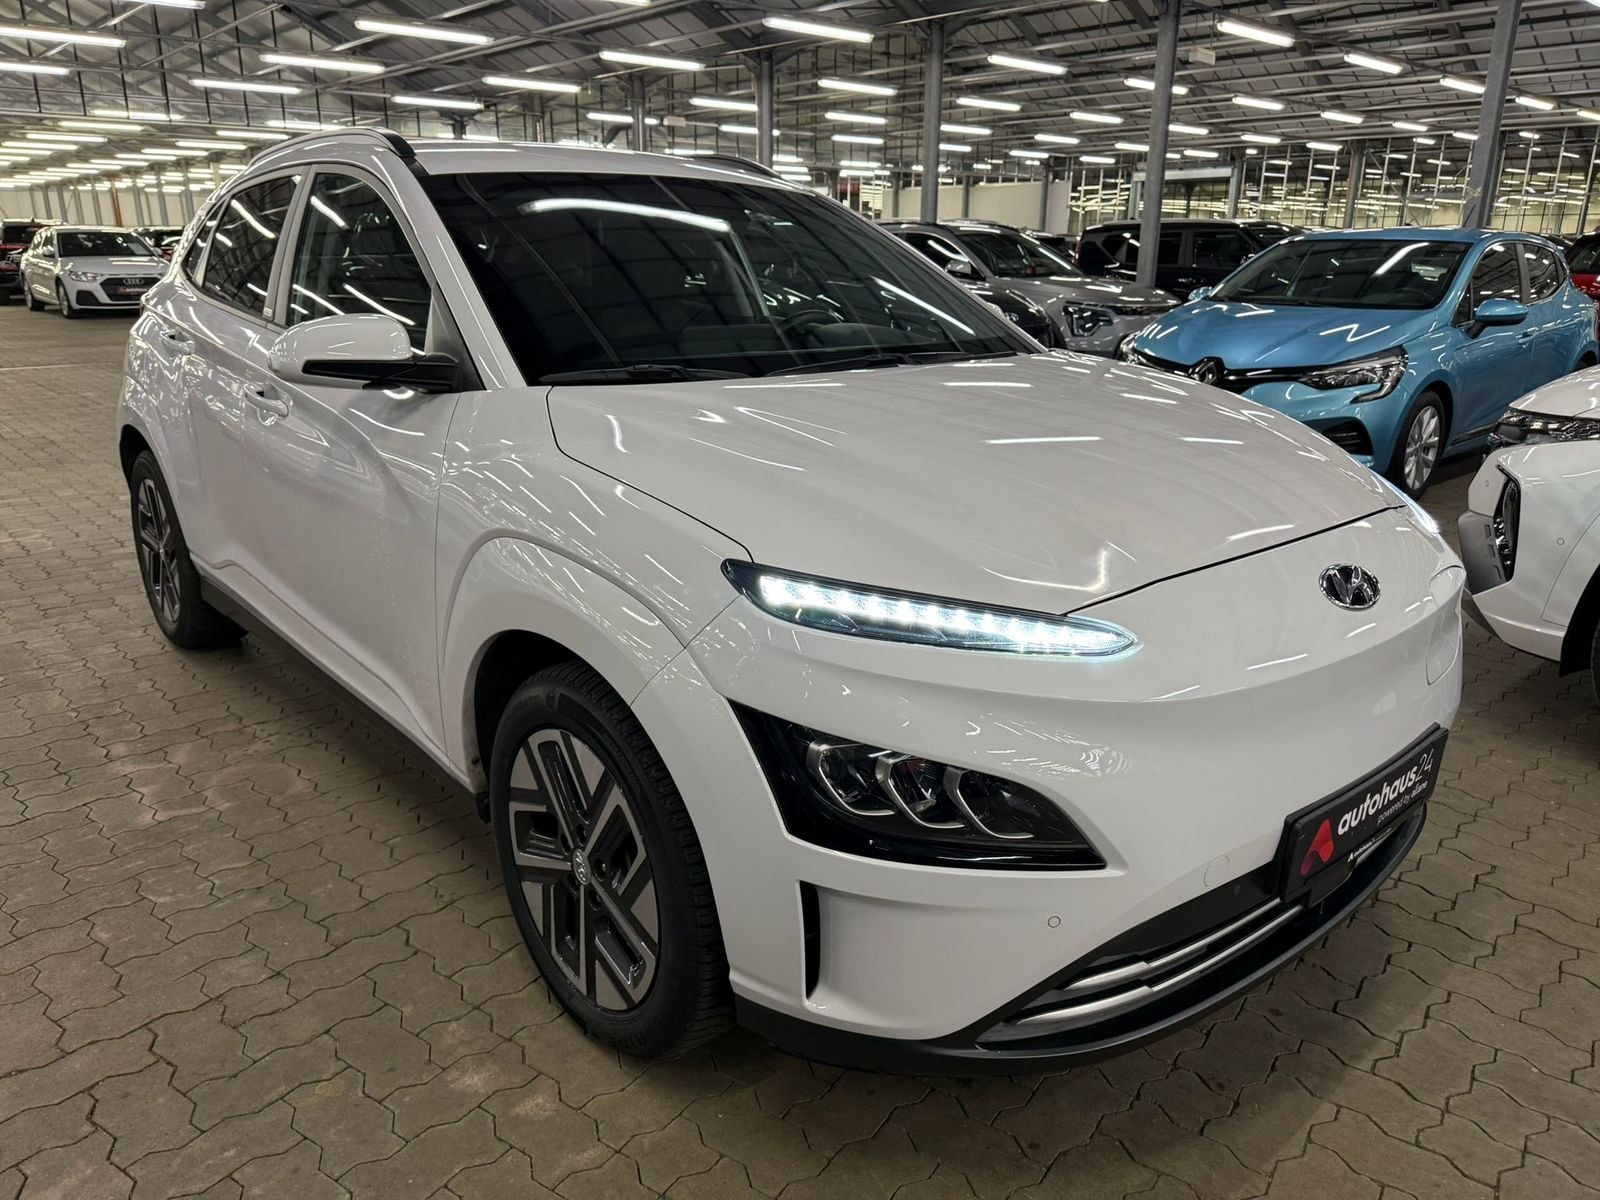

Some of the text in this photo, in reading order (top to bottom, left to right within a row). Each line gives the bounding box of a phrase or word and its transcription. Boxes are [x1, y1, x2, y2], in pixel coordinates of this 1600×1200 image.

[1337, 748, 1434, 836] autohaus24
[1377, 798, 1403, 827] powered
[1403, 794, 1411, 805] by
